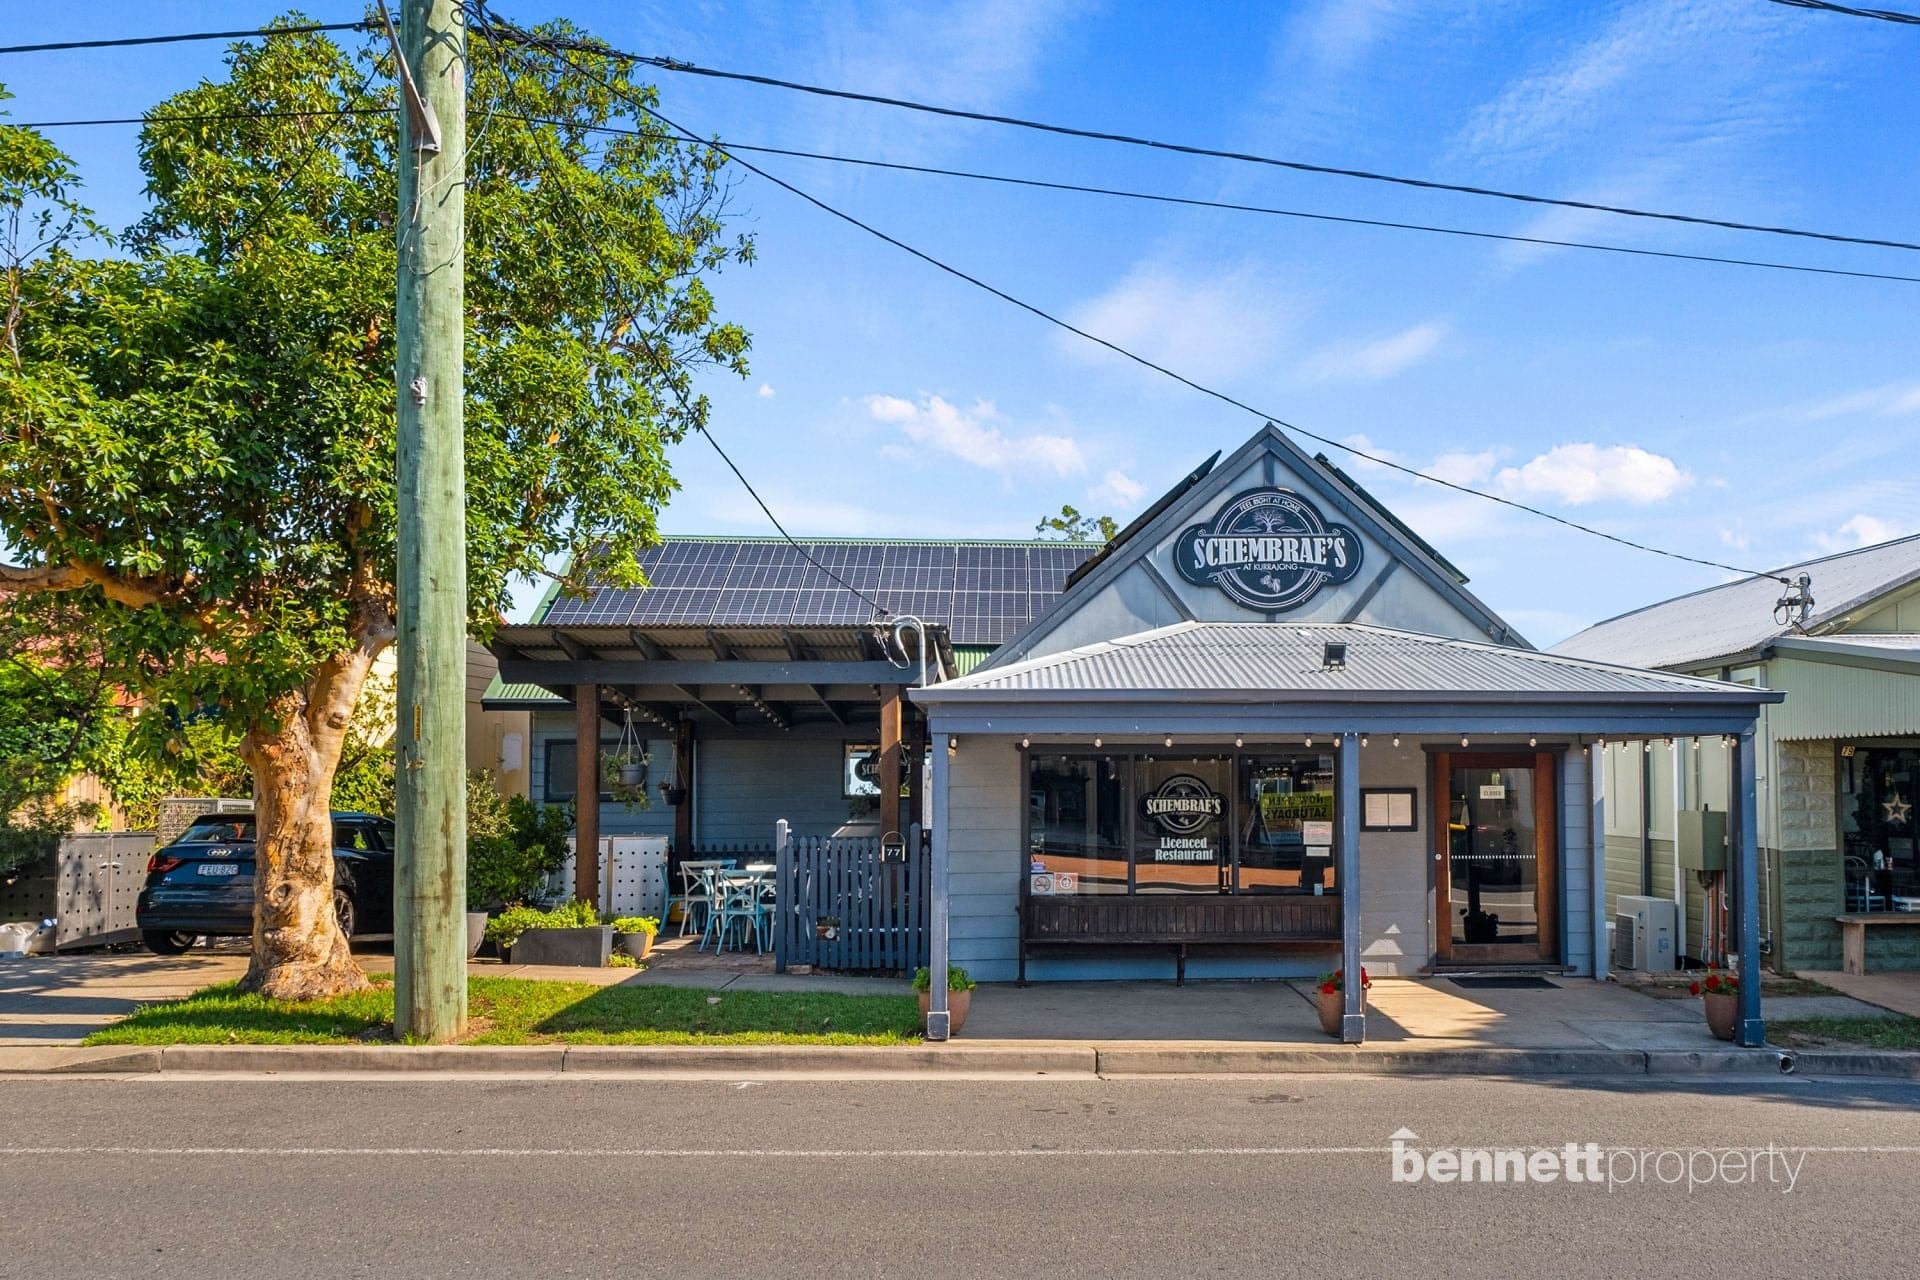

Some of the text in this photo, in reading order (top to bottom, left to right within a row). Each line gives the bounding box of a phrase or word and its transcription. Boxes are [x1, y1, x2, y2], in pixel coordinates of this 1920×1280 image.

[1193, 537, 1346, 569] SCHEMBRAE'S
[1146, 799, 1221, 815] SCHEMBRAE'S
[1160, 837, 1208, 849] Licenced
[886, 848, 901, 857] 77
[1155, 848, 1214, 861] Restaurant
